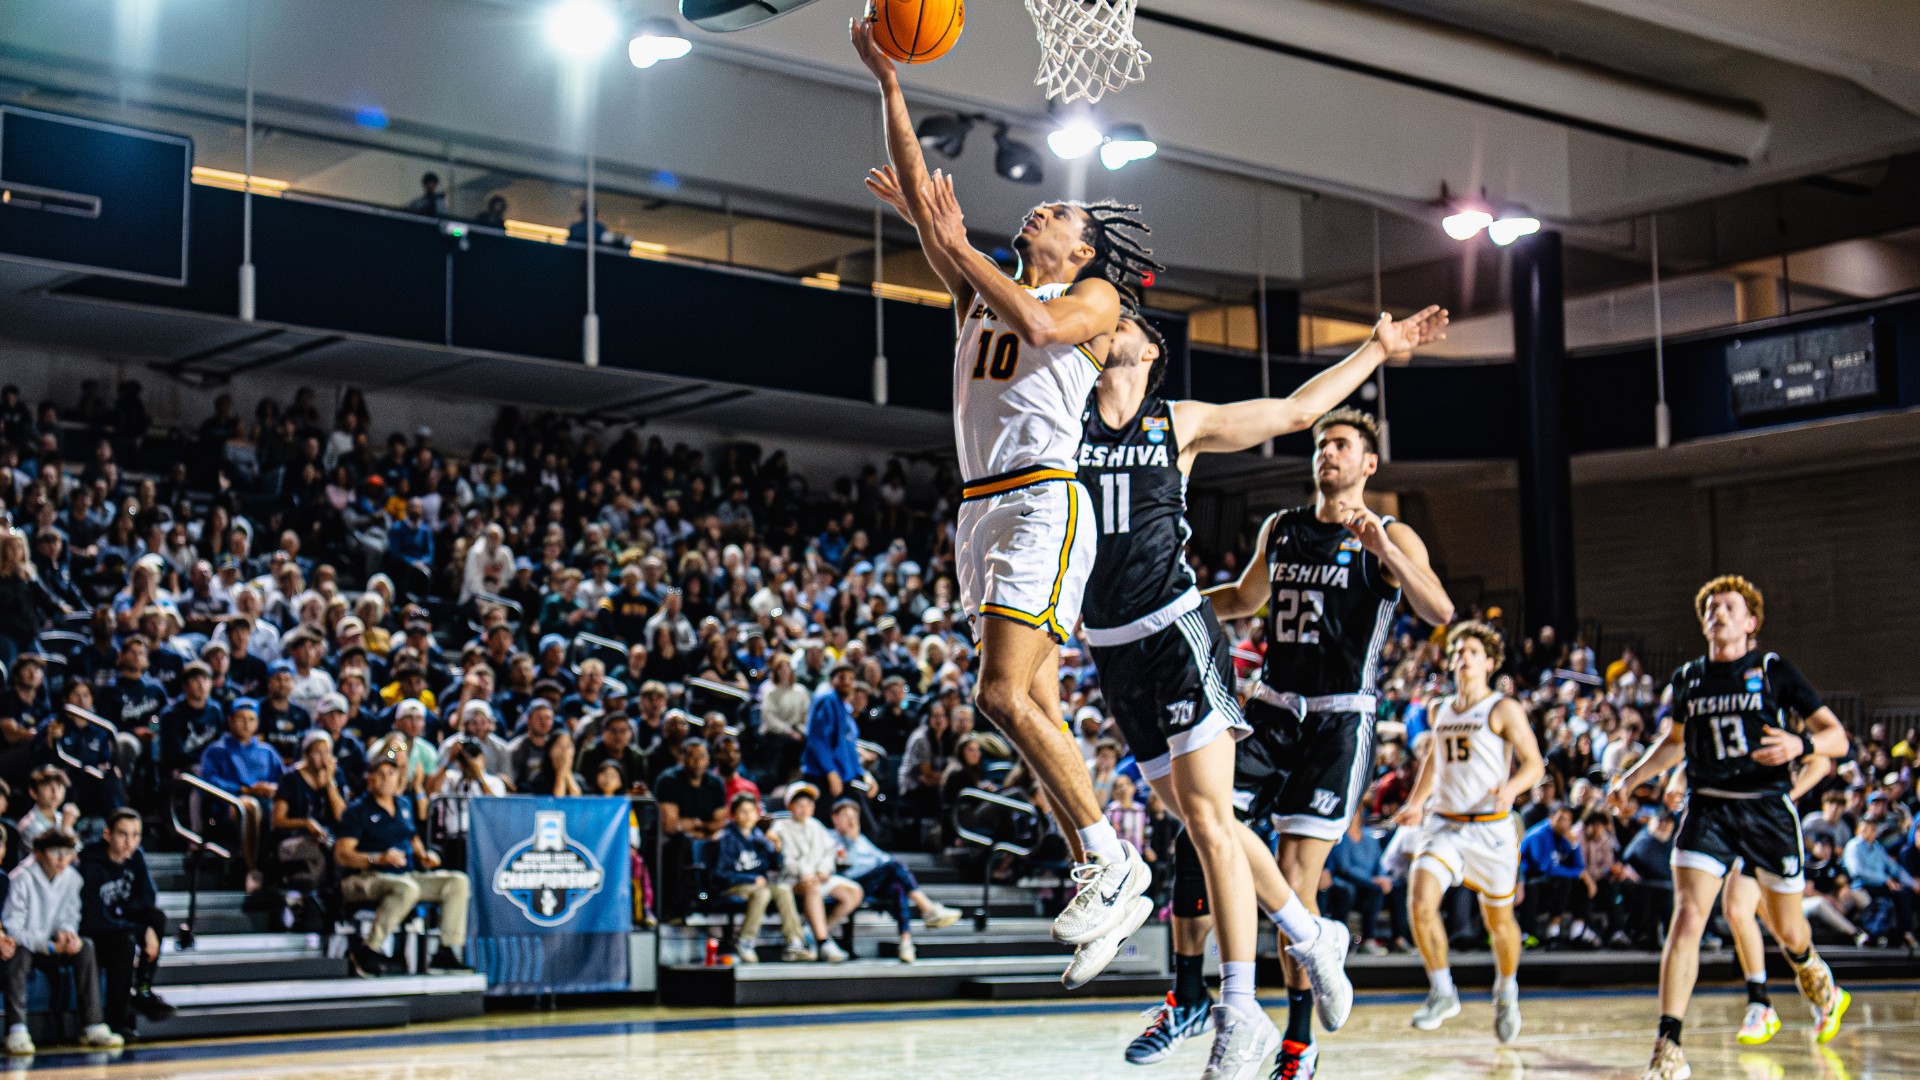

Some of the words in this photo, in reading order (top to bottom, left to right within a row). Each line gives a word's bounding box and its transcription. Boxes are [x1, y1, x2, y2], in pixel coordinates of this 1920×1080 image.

[972, 328, 1021, 382] 10
[1078, 442, 1169, 468] ESHIVA
[1099, 473, 1130, 534] 11
[1269, 562, 1349, 589] YESHIVA
[1276, 588, 1325, 644] 22
[1687, 692, 1764, 718] YESHIVA
[1445, 736, 1471, 764] 15
[1709, 714, 1749, 760] 13
[1309, 787, 1341, 816] YU
[497, 870, 601, 890] CHAMPIONSHIP
